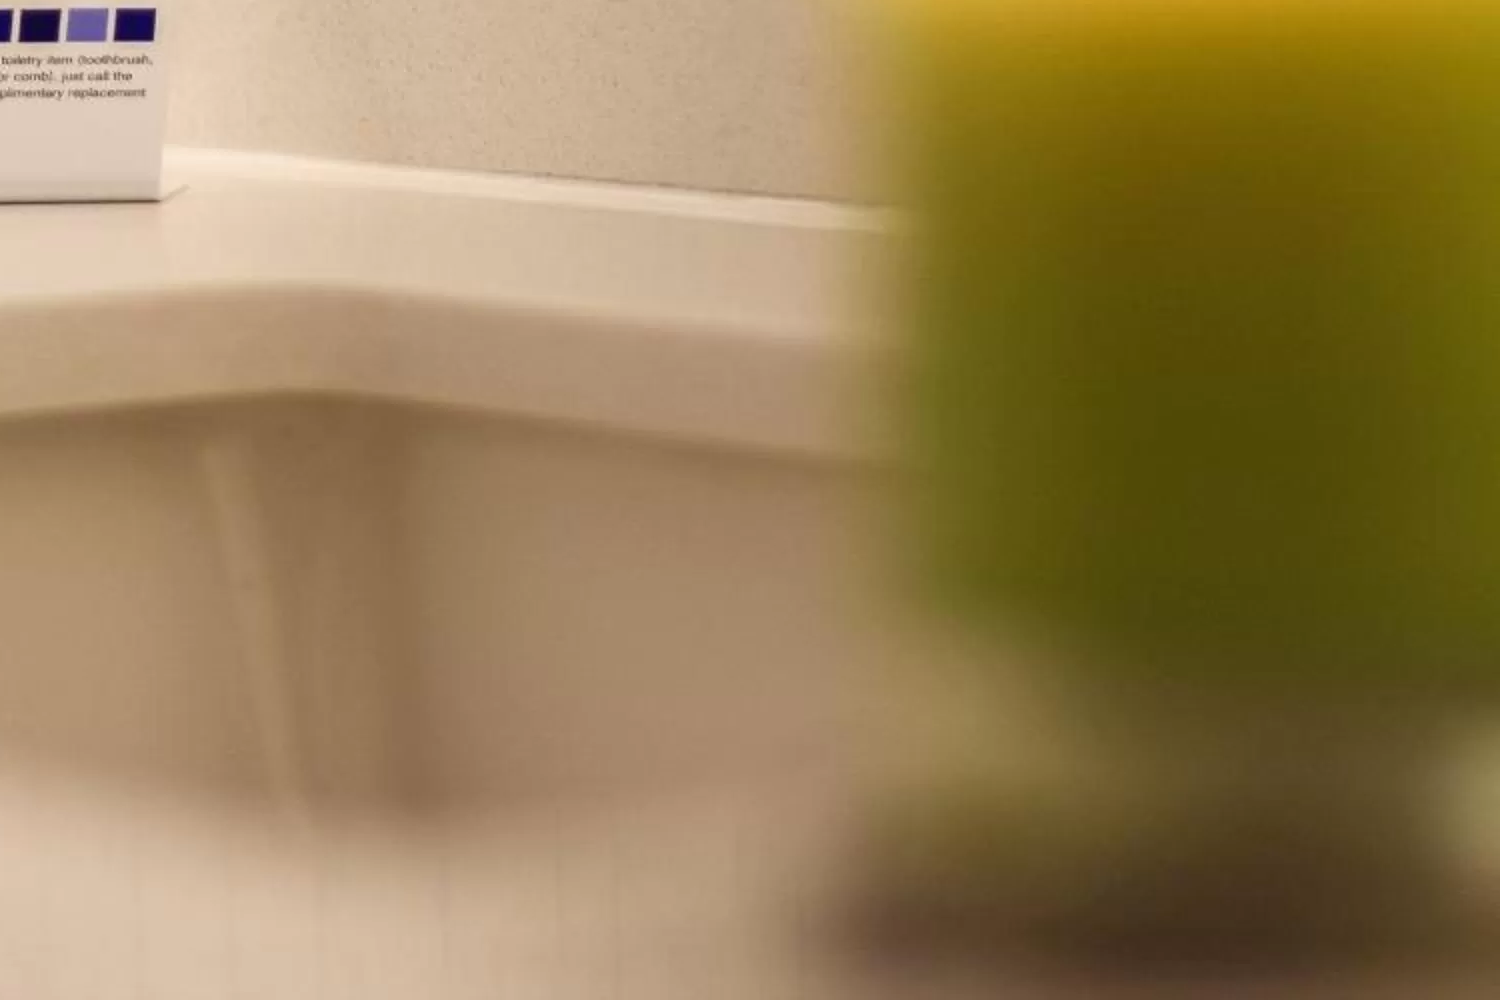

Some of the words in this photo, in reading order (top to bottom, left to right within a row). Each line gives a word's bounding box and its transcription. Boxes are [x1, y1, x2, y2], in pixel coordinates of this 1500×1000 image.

[1, 56, 42, 67] toiletry
[46, 55, 73, 65] item
[77, 53, 153, 66] (toothbrush,
[60, 71, 84, 83] just
[87, 70, 109, 81] call
[113, 70, 133, 80] the
[67, 87, 147, 98] replacement
